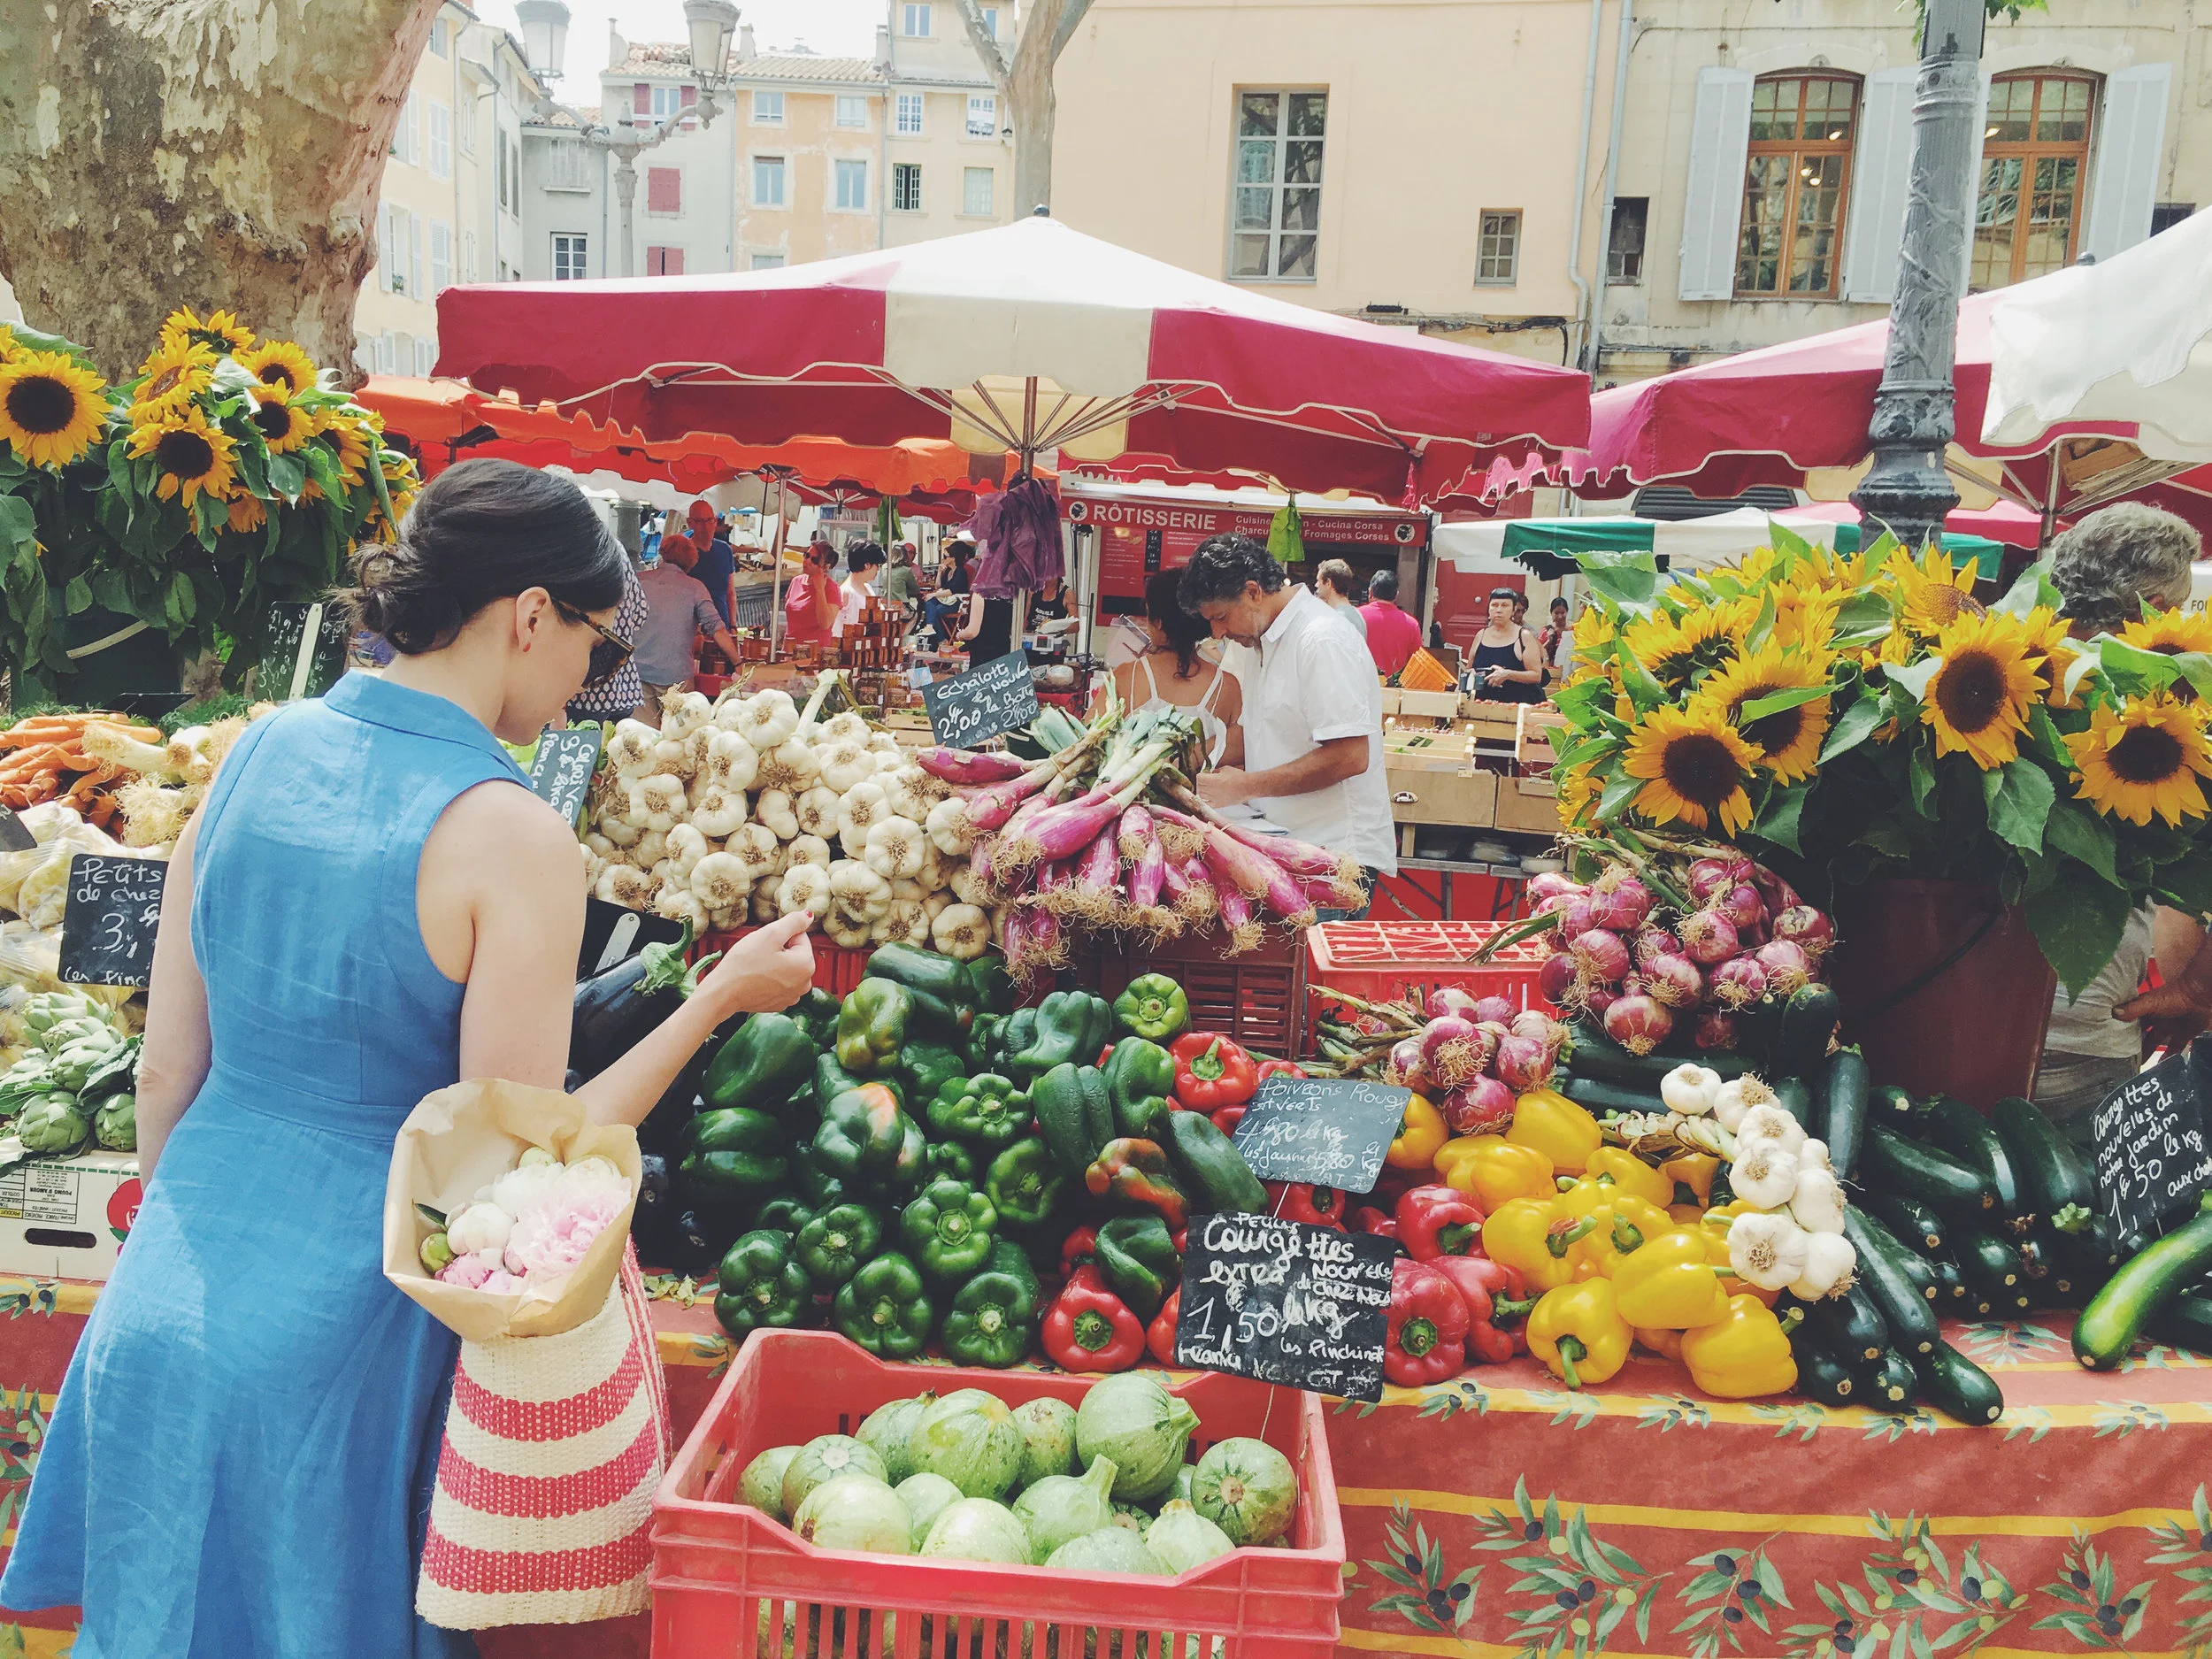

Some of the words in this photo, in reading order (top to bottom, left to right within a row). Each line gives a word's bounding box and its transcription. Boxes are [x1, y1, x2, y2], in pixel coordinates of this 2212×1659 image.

[1094, 503, 1217, 530] RÔTISSERIE
[1235, 515, 1271, 525] Cuisine
[1318, 519, 1352, 529] Cucina
[1354, 520, 1383, 531] Corsa
[1304, 529, 1352, 540] Fromages
[1355, 532, 1389, 541] Corses
